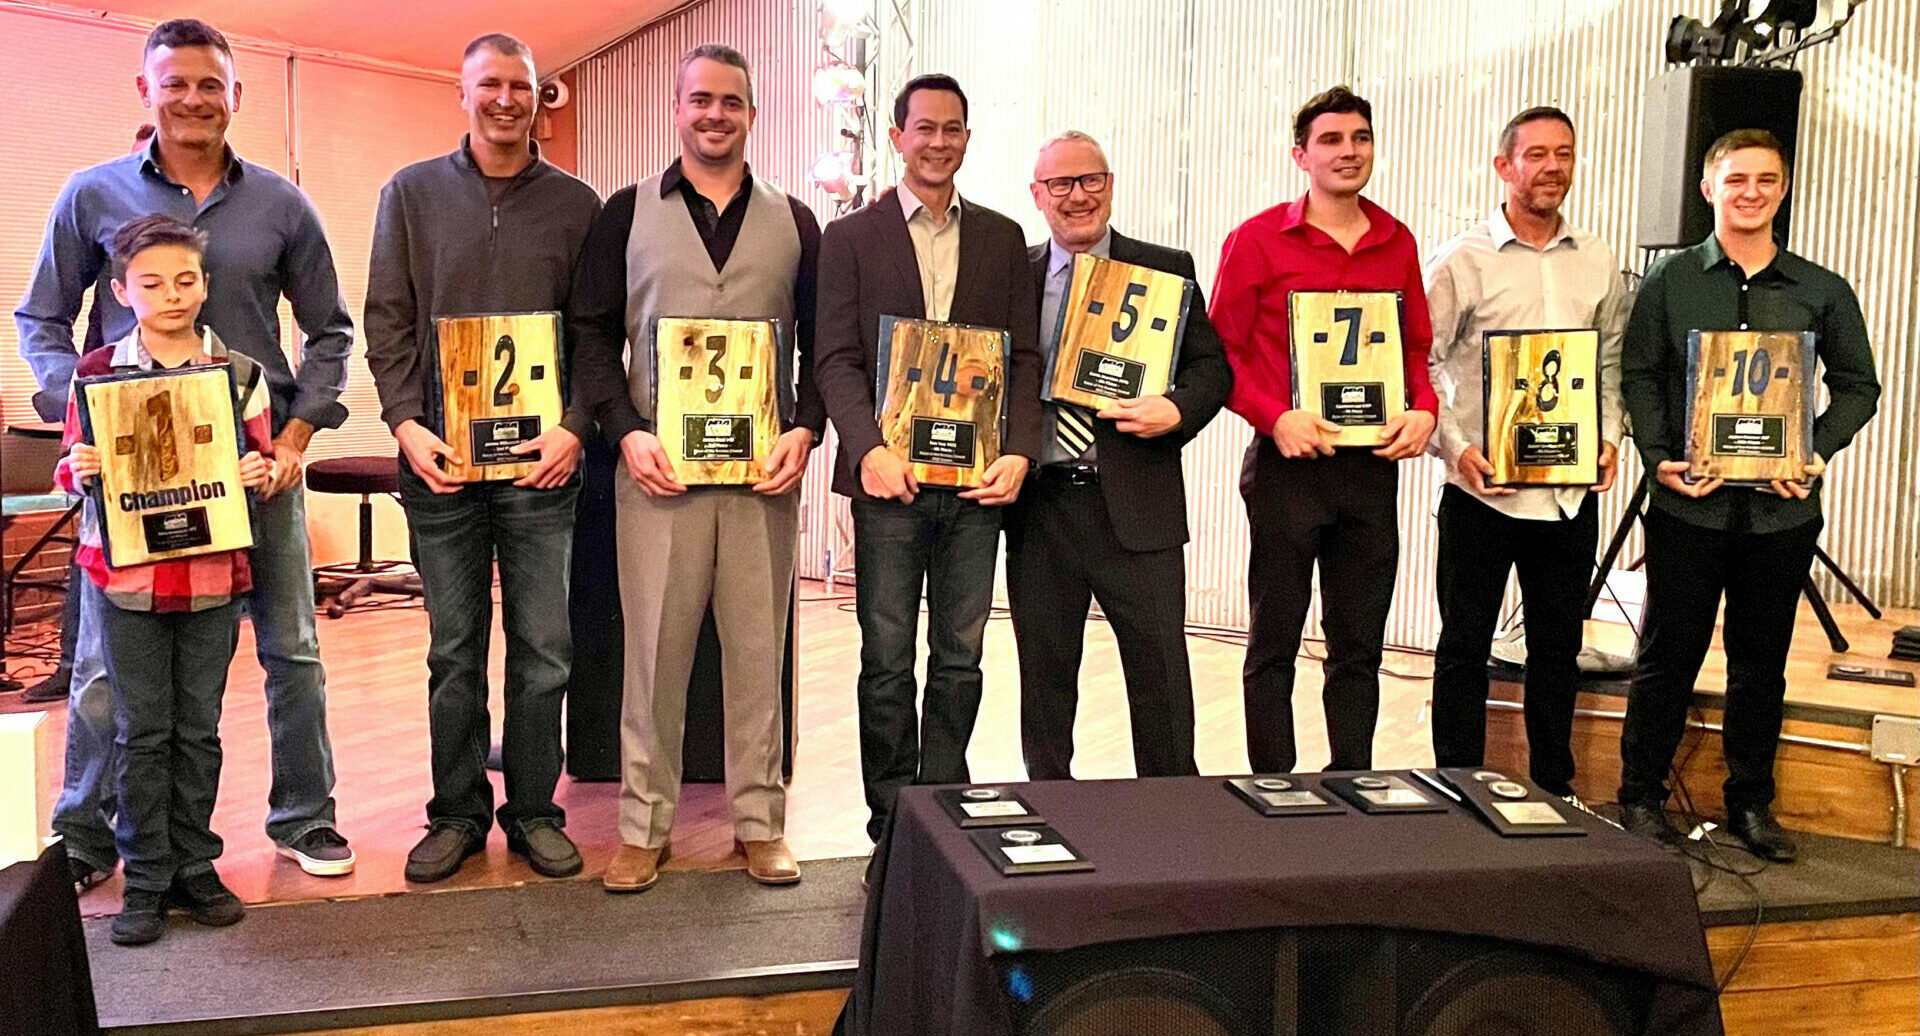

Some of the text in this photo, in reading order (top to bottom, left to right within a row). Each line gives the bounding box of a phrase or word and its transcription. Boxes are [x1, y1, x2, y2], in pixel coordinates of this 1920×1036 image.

[1111, 282, 1148, 343] 5
[1334, 307, 1363, 365] 7
[493, 334, 516, 407] 2
[705, 335, 727, 404] 3
[933, 342, 958, 408] 4
[1536, 349, 1562, 412] 8
